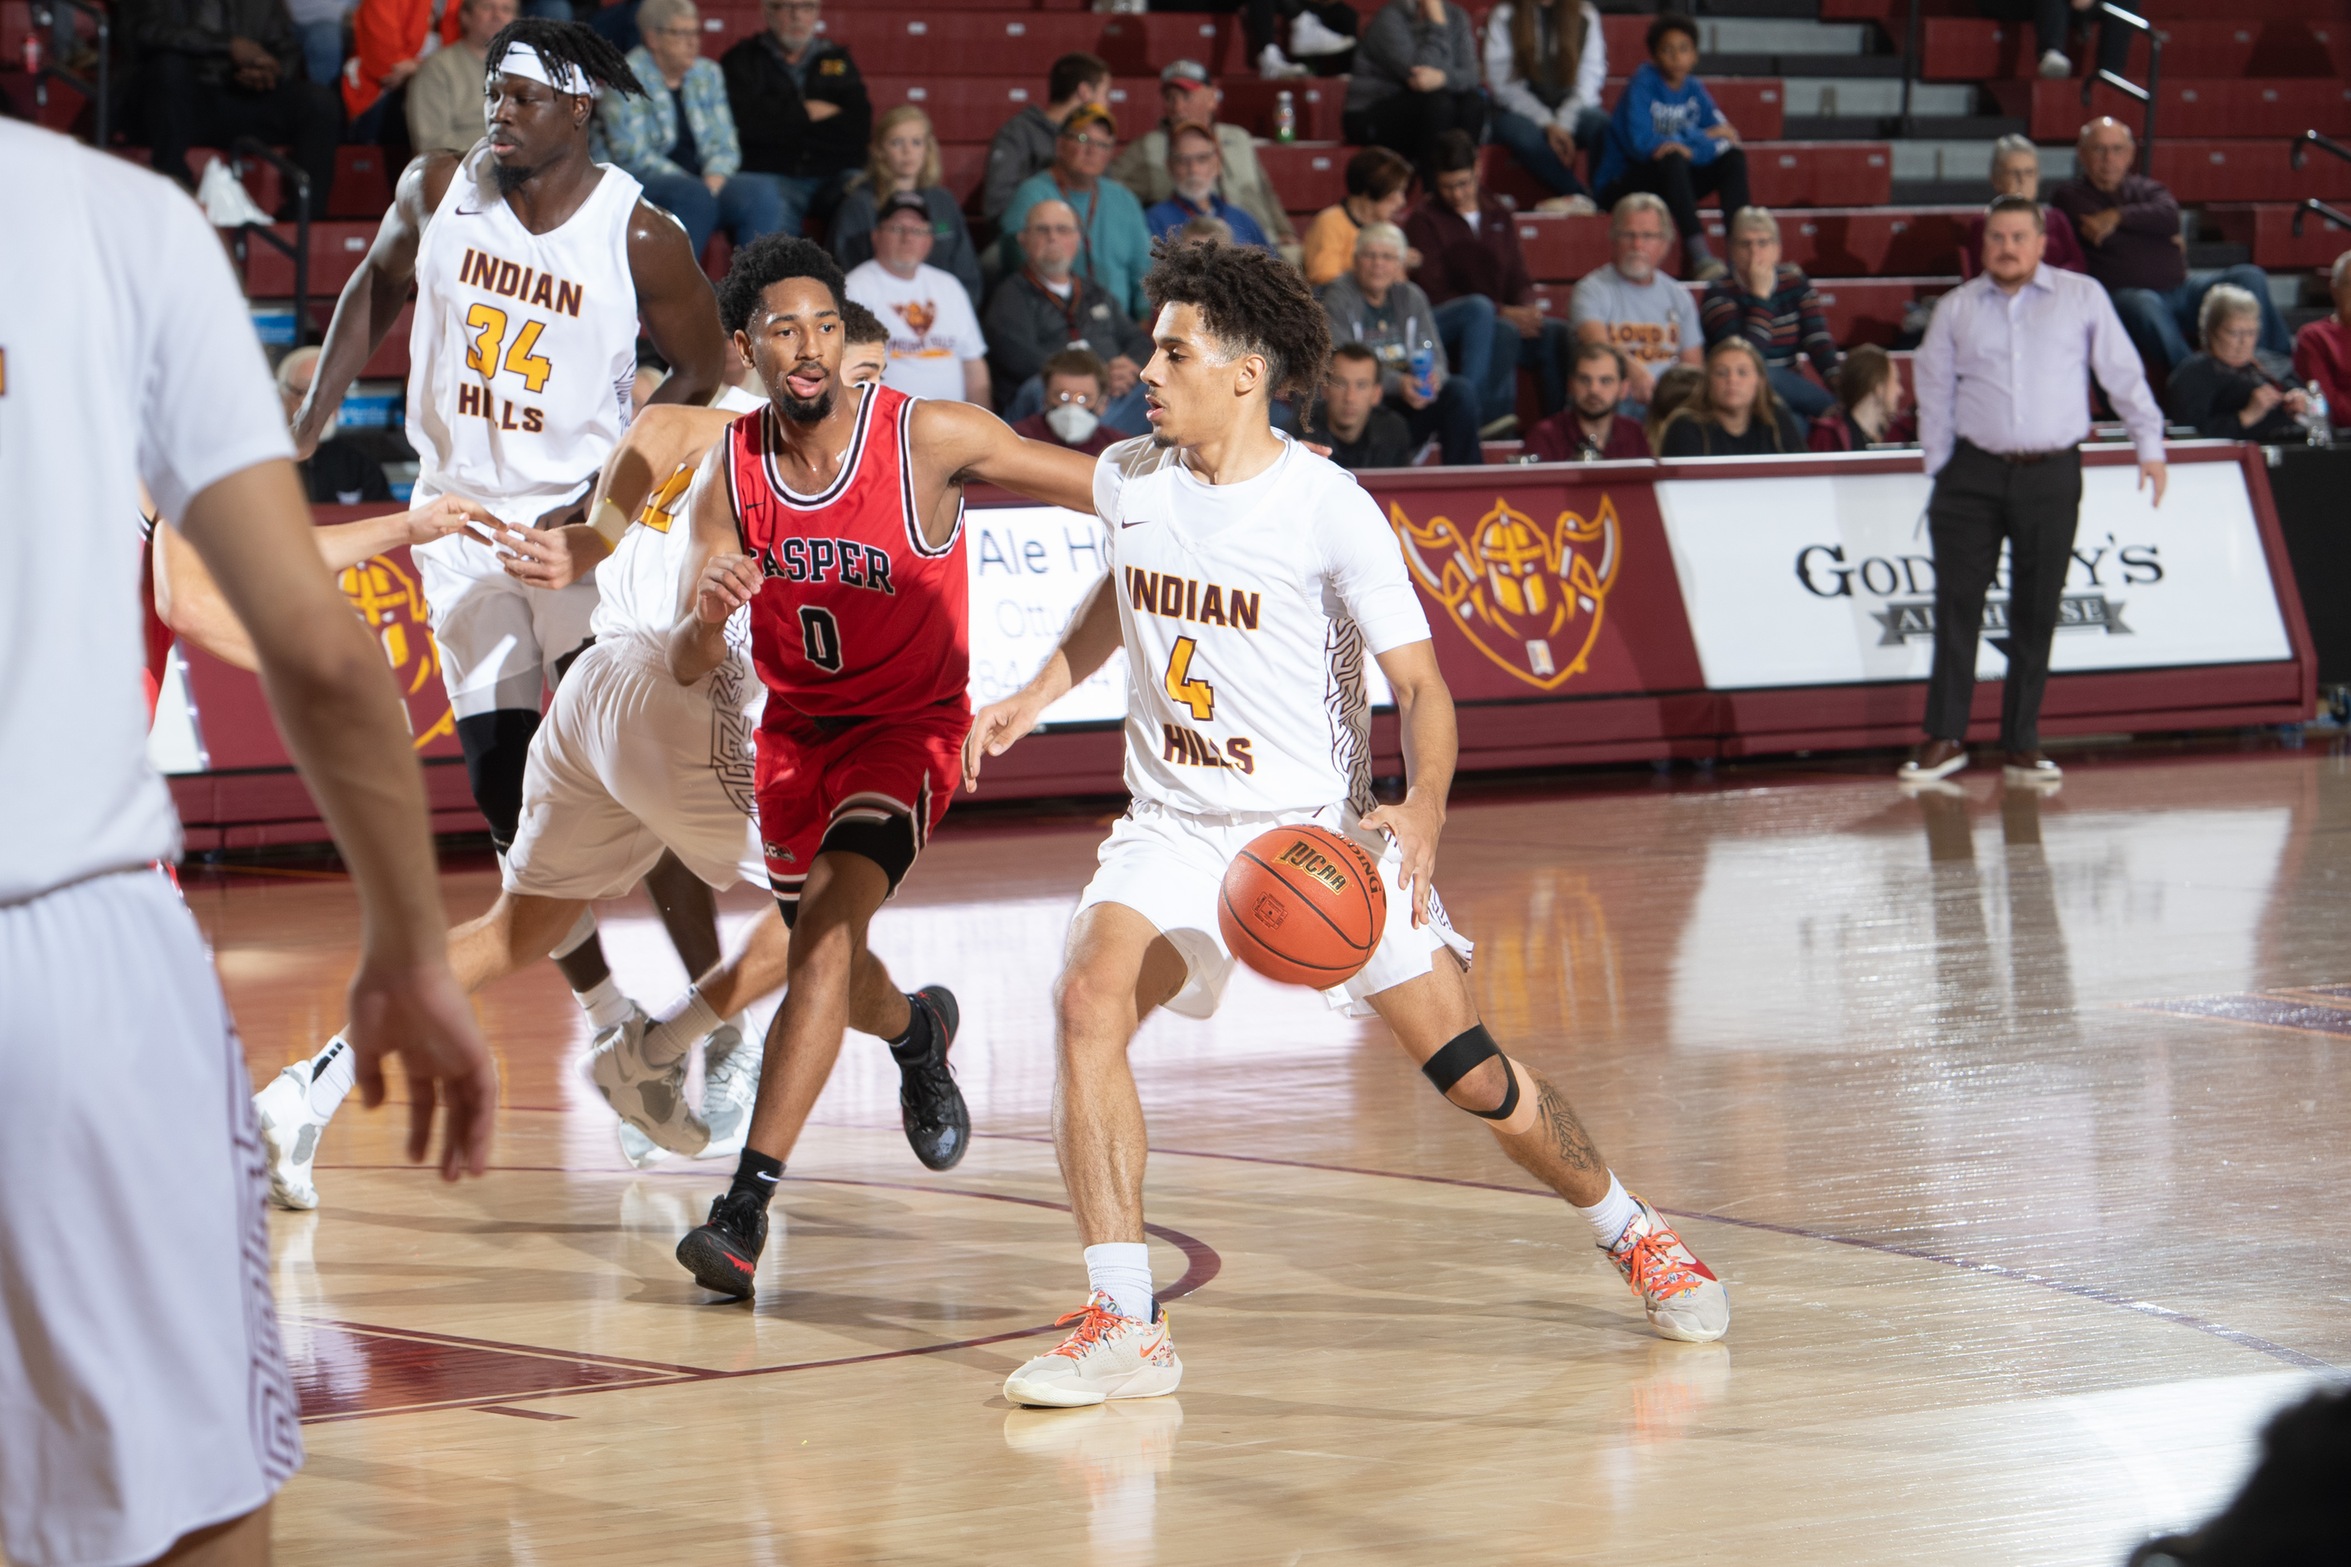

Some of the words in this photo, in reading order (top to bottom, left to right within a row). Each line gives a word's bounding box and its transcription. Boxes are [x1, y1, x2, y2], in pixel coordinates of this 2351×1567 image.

[458, 248, 583, 318] INDIAN
[465, 302, 552, 394] 34
[749, 537, 896, 596] ASPER
[979, 528, 1049, 576] Ale
[1125, 565, 1261, 631] INDIAN
[797, 604, 844, 674] 0
[1164, 635, 1215, 722] 4
[1277, 839, 1348, 894] NJCAA
